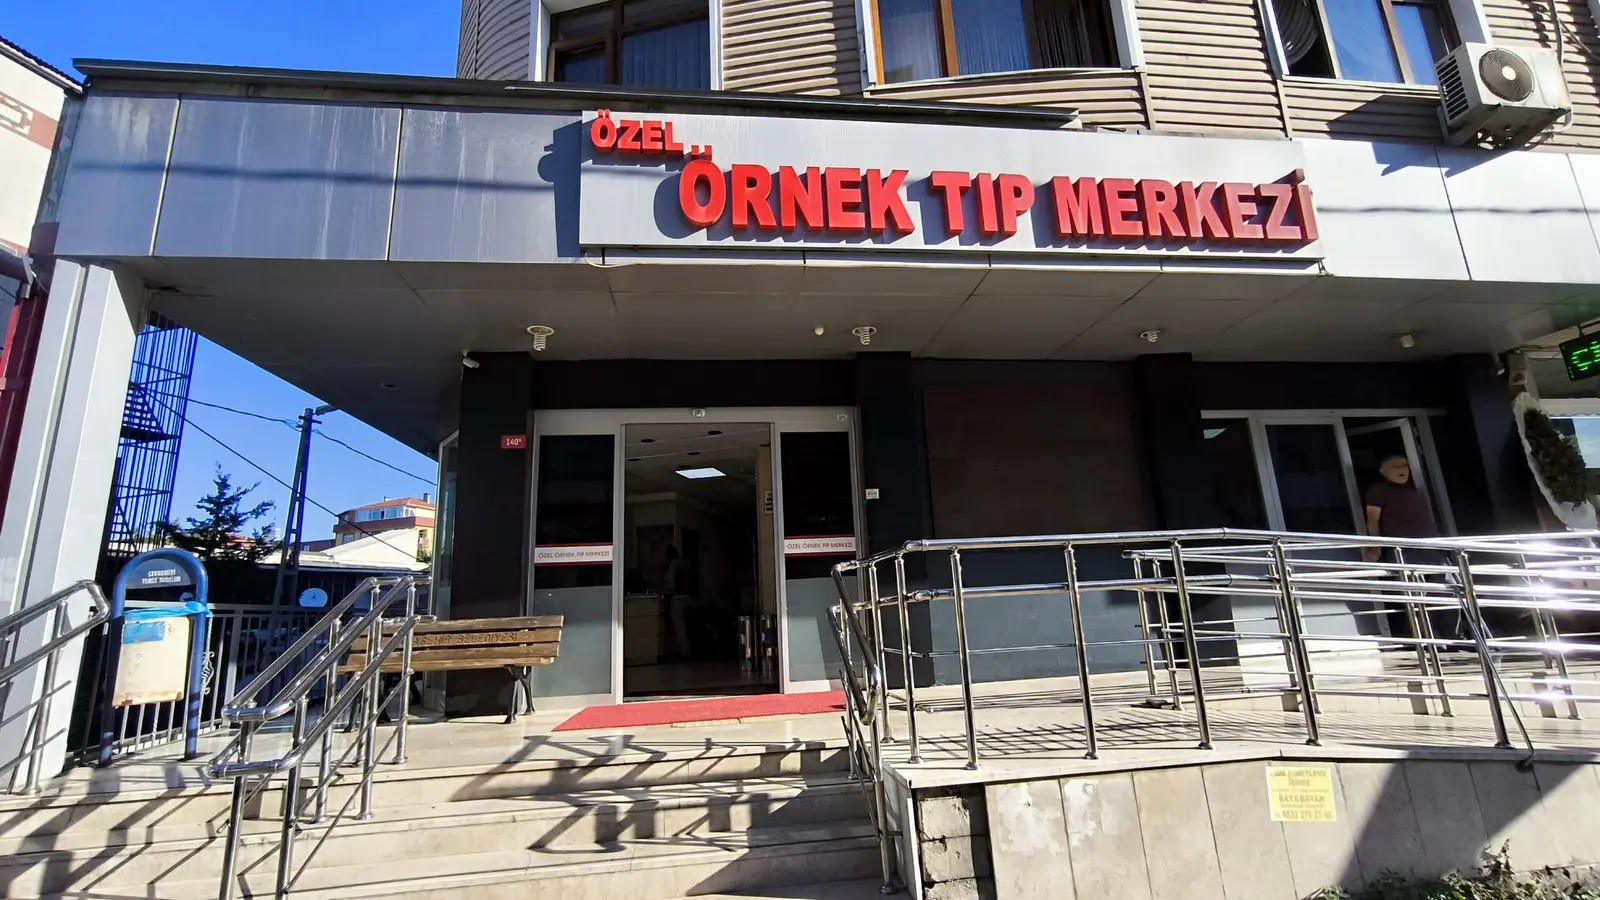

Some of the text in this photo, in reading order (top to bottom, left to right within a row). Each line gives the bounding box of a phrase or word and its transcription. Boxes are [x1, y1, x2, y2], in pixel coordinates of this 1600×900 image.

[590, 109, 684, 152] ÖZEL
[679, 145, 1319, 242] ÖRNEK TIP MERKEZİ
